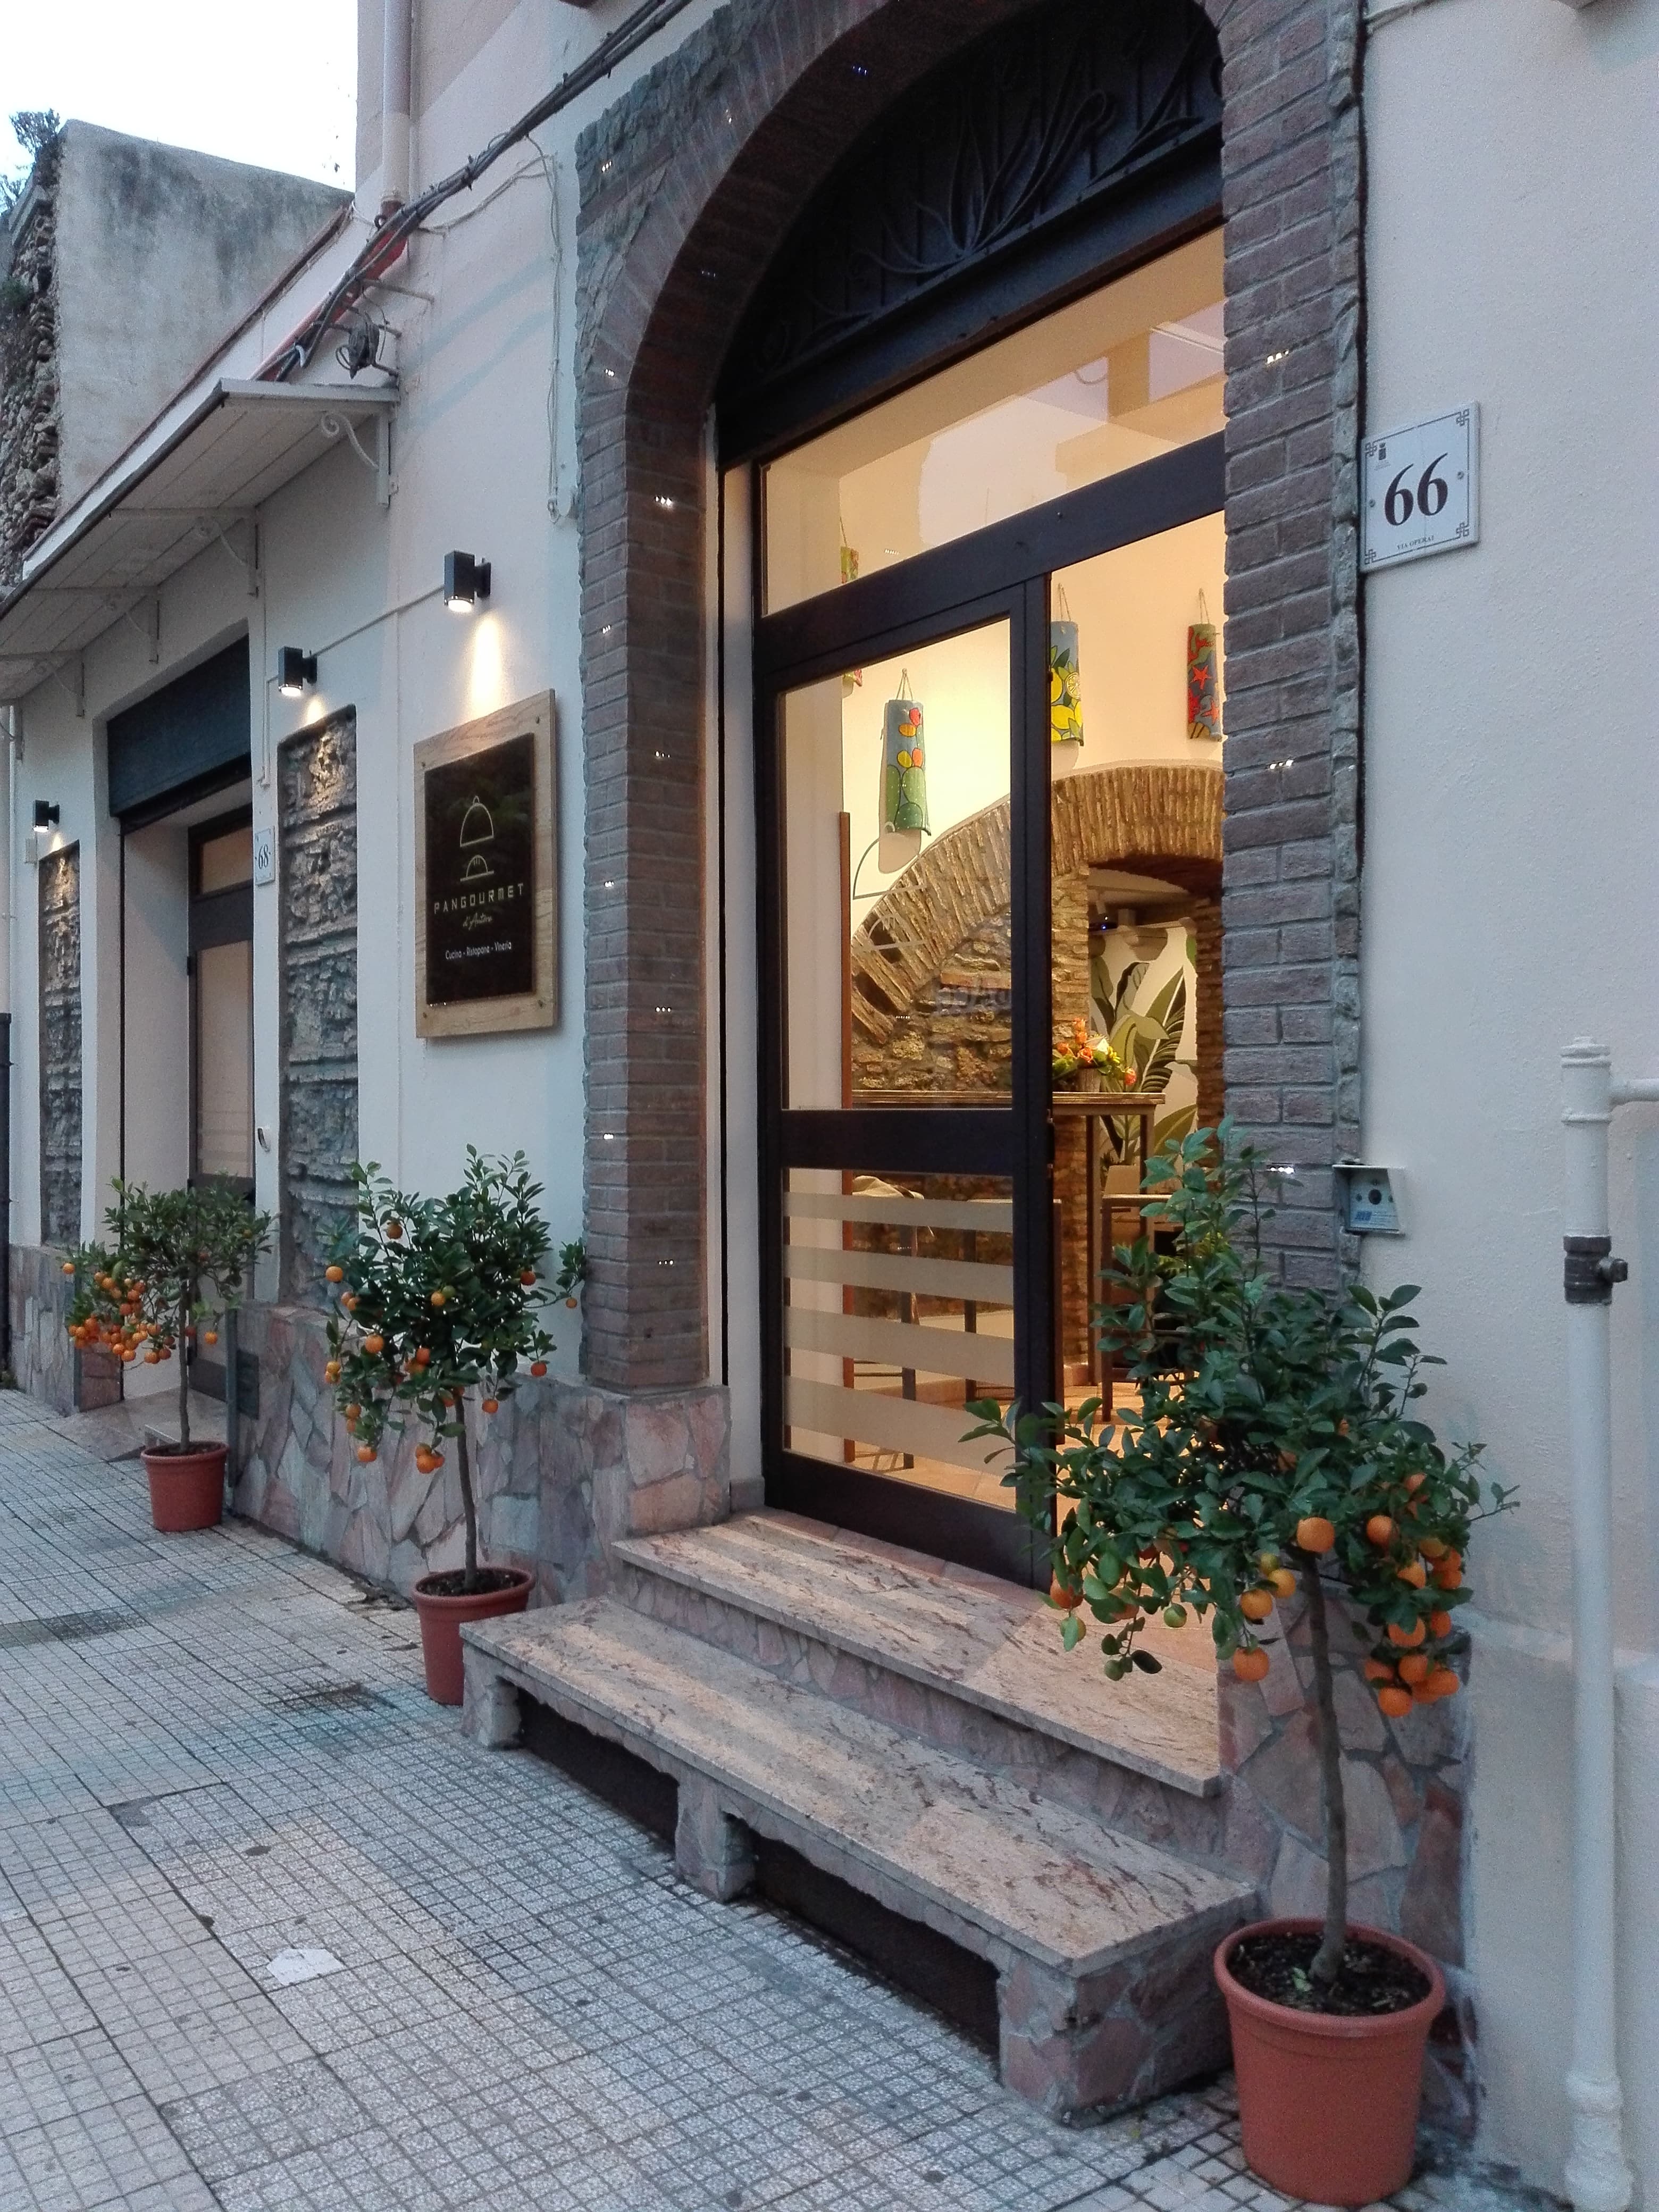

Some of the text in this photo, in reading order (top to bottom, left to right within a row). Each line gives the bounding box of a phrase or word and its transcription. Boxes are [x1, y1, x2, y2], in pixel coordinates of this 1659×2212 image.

[1384, 452, 1448, 526] 66
[258, 843, 269, 869] 68
[434, 883, 524, 914] PANGOURMET
[445, 950, 462, 960] Cucina
[466, 945, 490, 957] Ristopane
